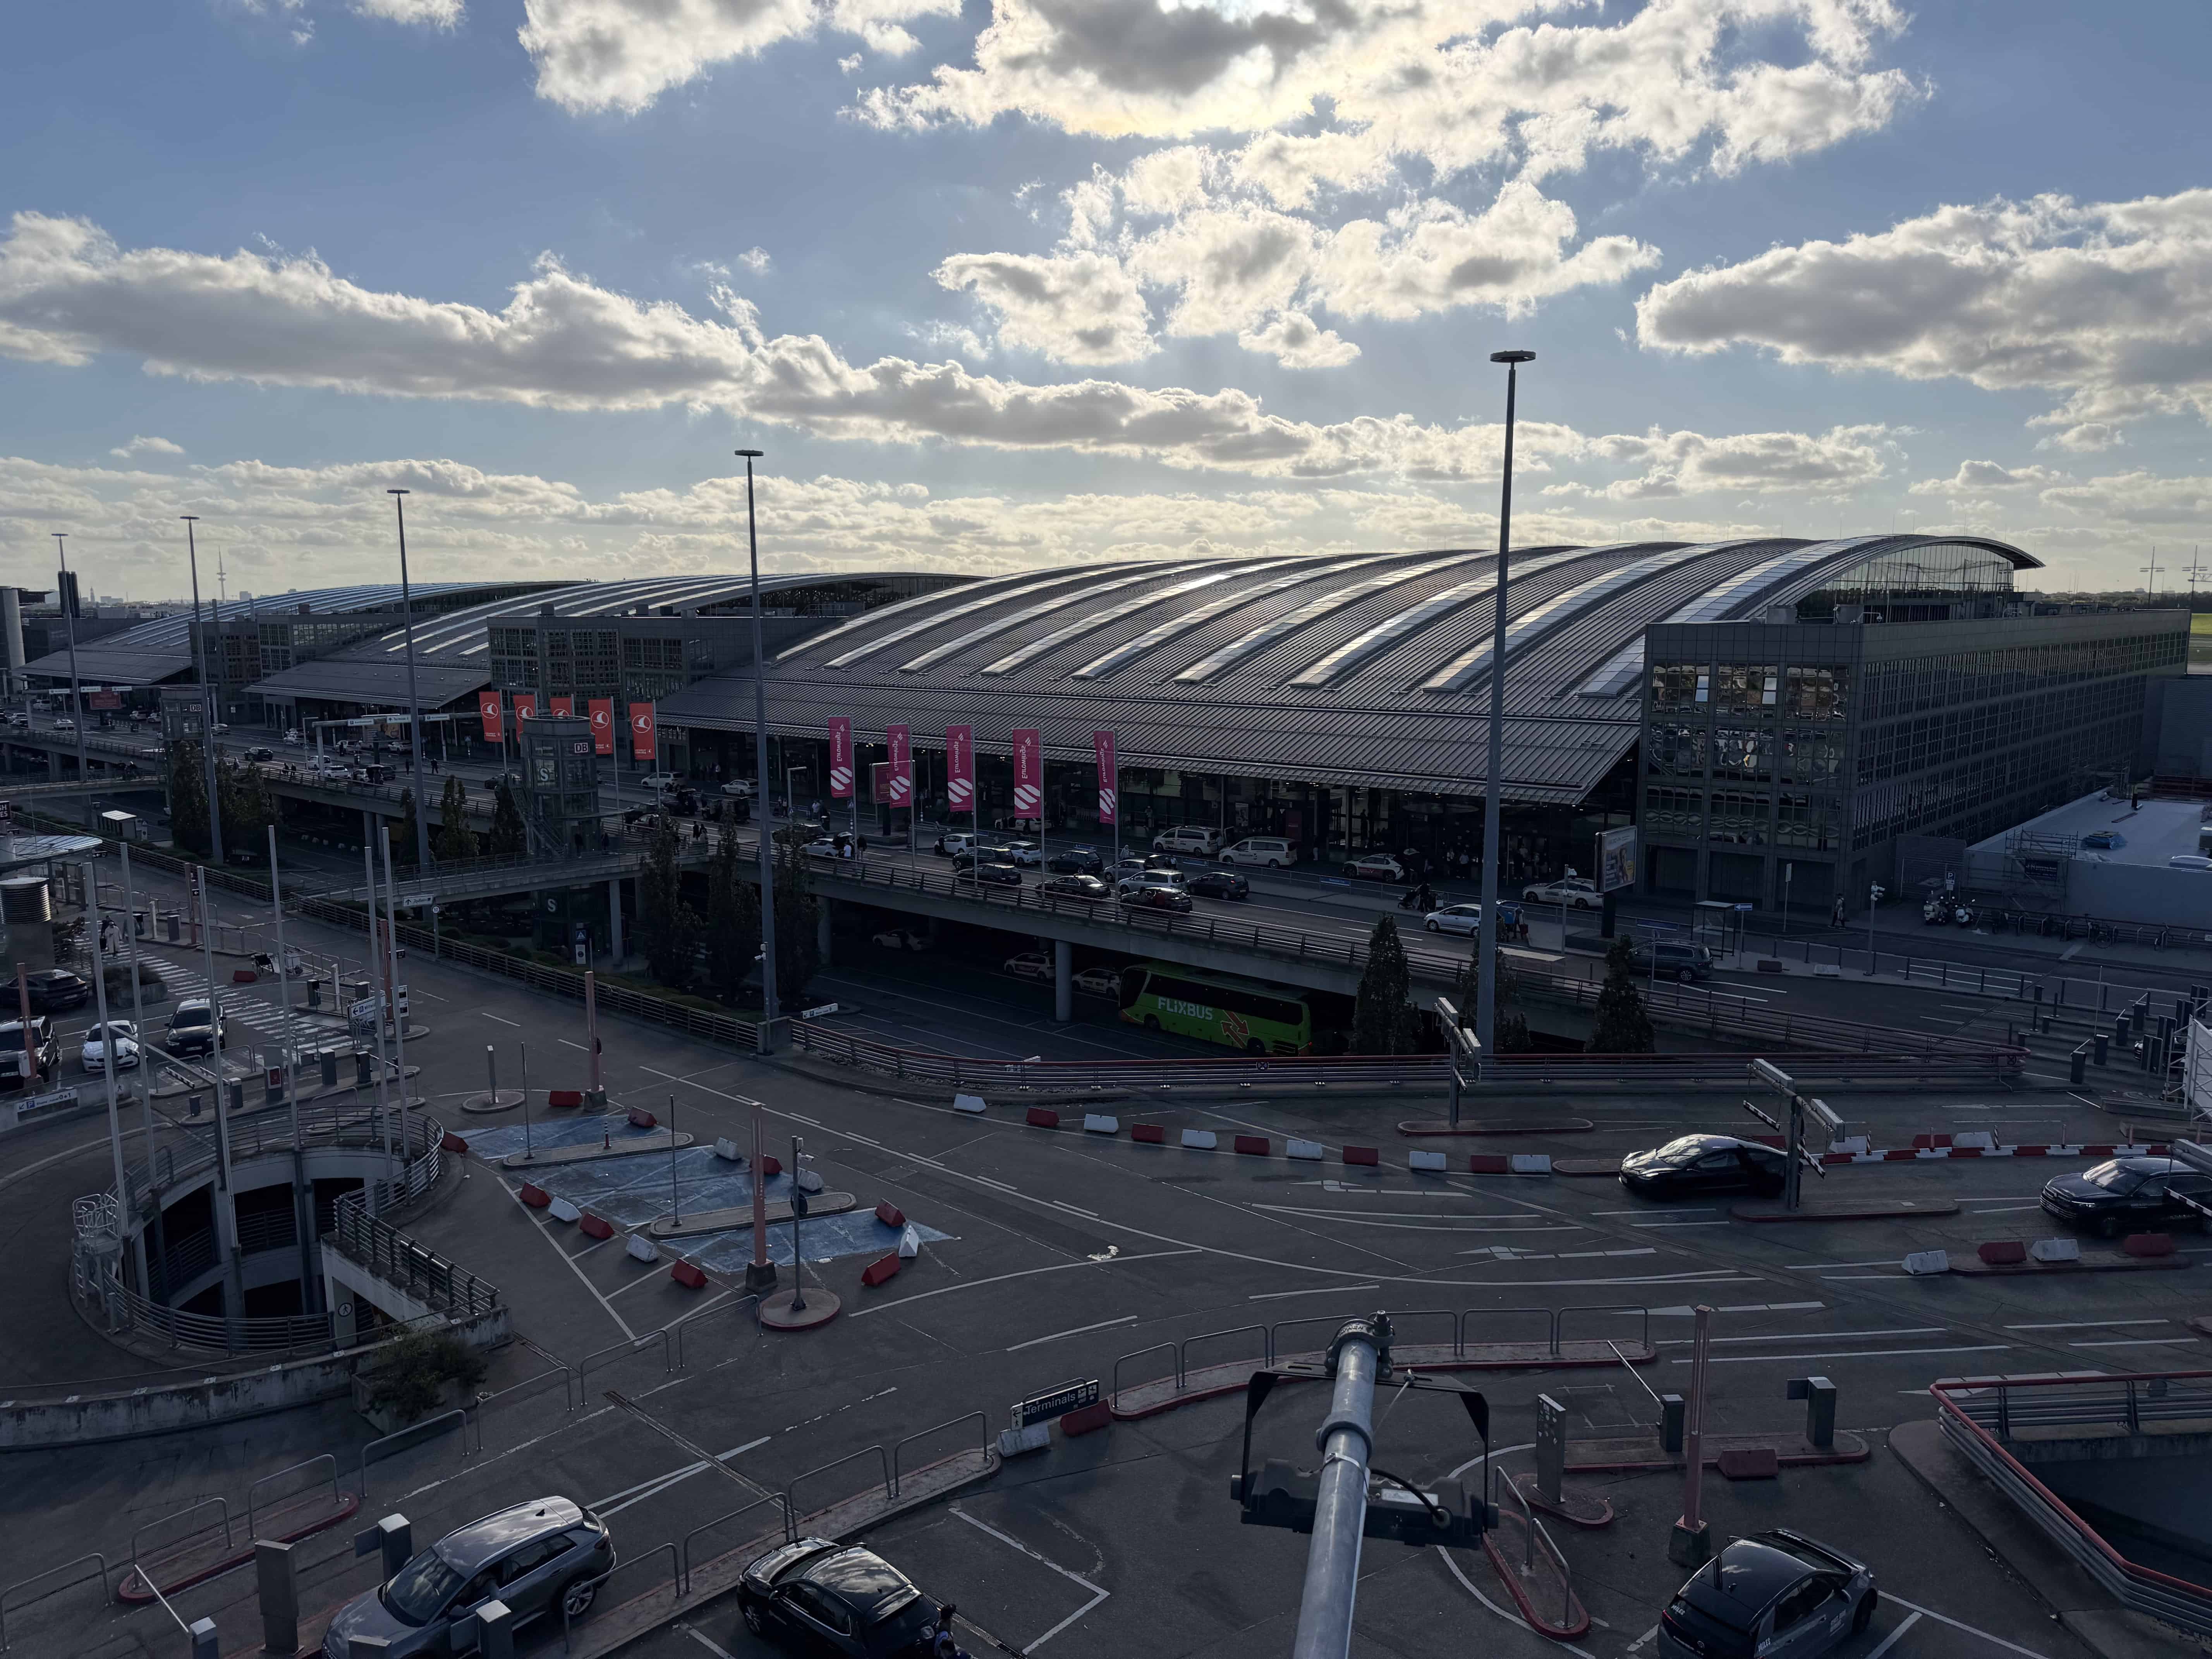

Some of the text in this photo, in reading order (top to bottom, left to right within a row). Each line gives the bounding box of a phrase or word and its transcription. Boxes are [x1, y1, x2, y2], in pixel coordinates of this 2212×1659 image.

[575, 743, 587, 752] DB
[540, 768, 549, 781] S
[547, 898, 556, 912] S
[1025, 1393, 1076, 1415] Terminals
[1671, 1604, 1685, 1616] MILES
[1758, 1637, 1771, 1652] MILES
